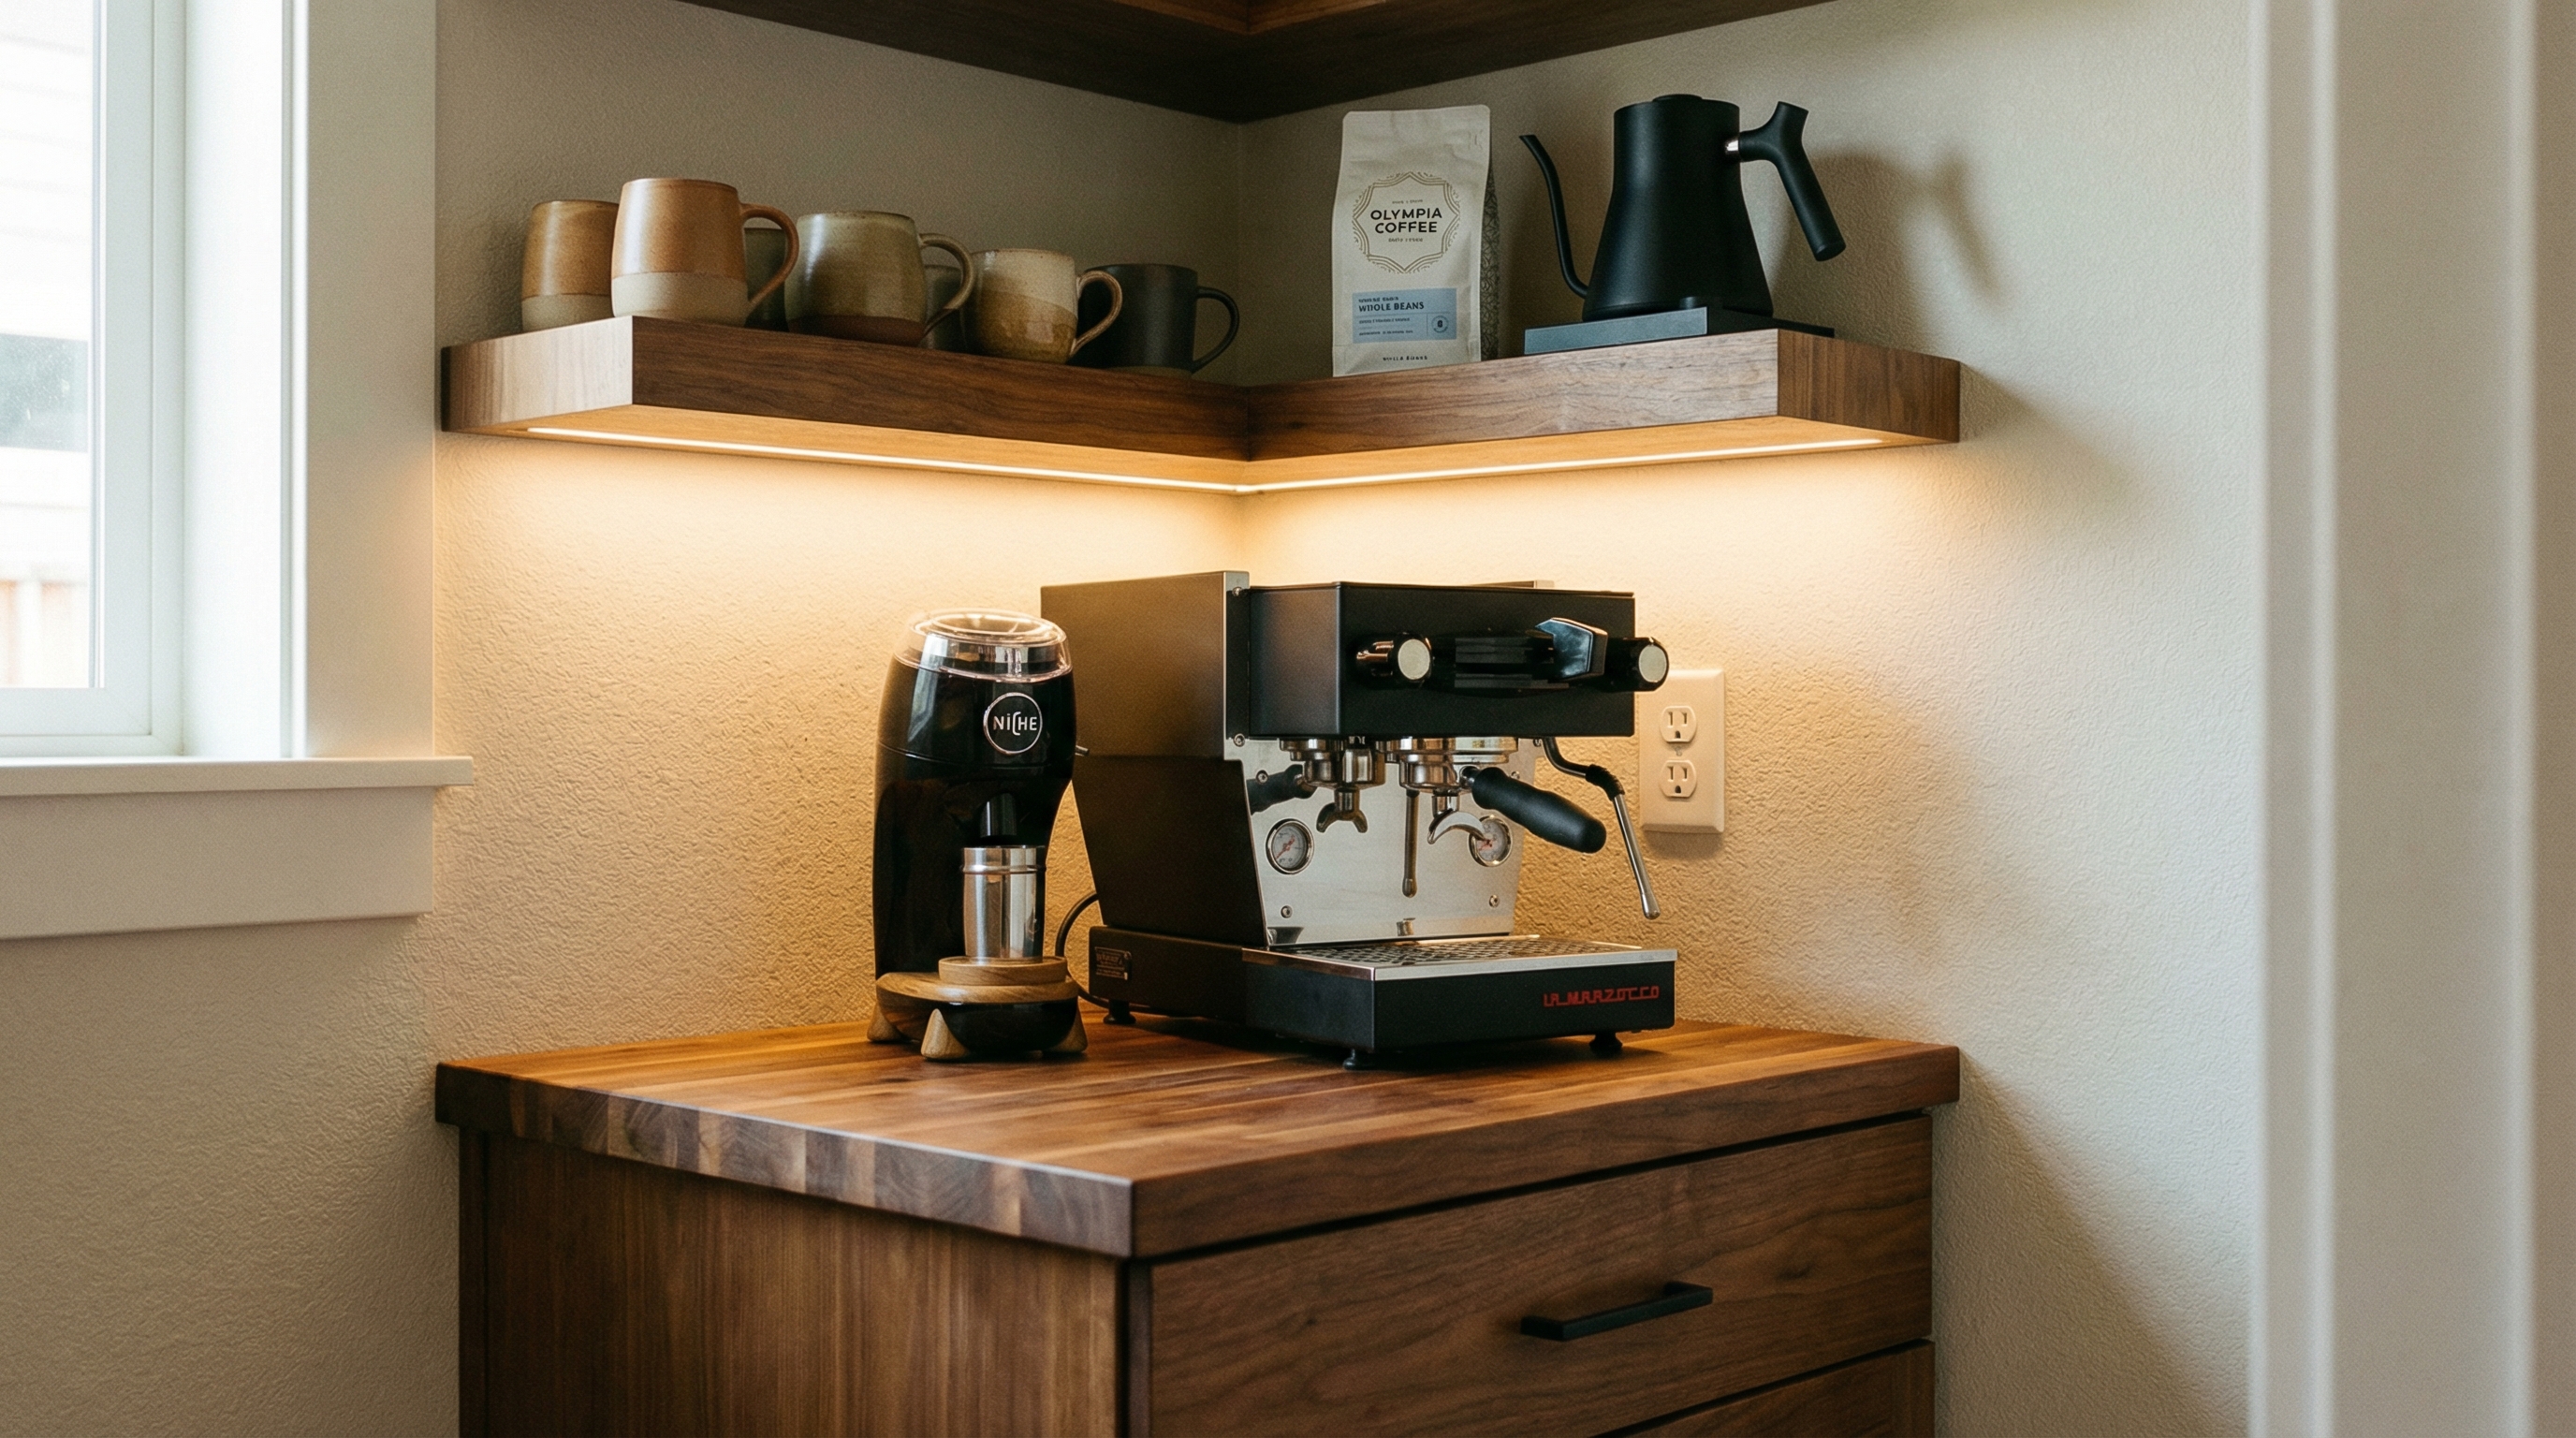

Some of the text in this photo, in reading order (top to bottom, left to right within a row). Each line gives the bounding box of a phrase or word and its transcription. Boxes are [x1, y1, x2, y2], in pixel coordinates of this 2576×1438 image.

[1370, 207, 1442, 221] OLYMPIA
[1375, 221, 1438, 234] COFFEE
[1394, 301, 1425, 311] BEANS
